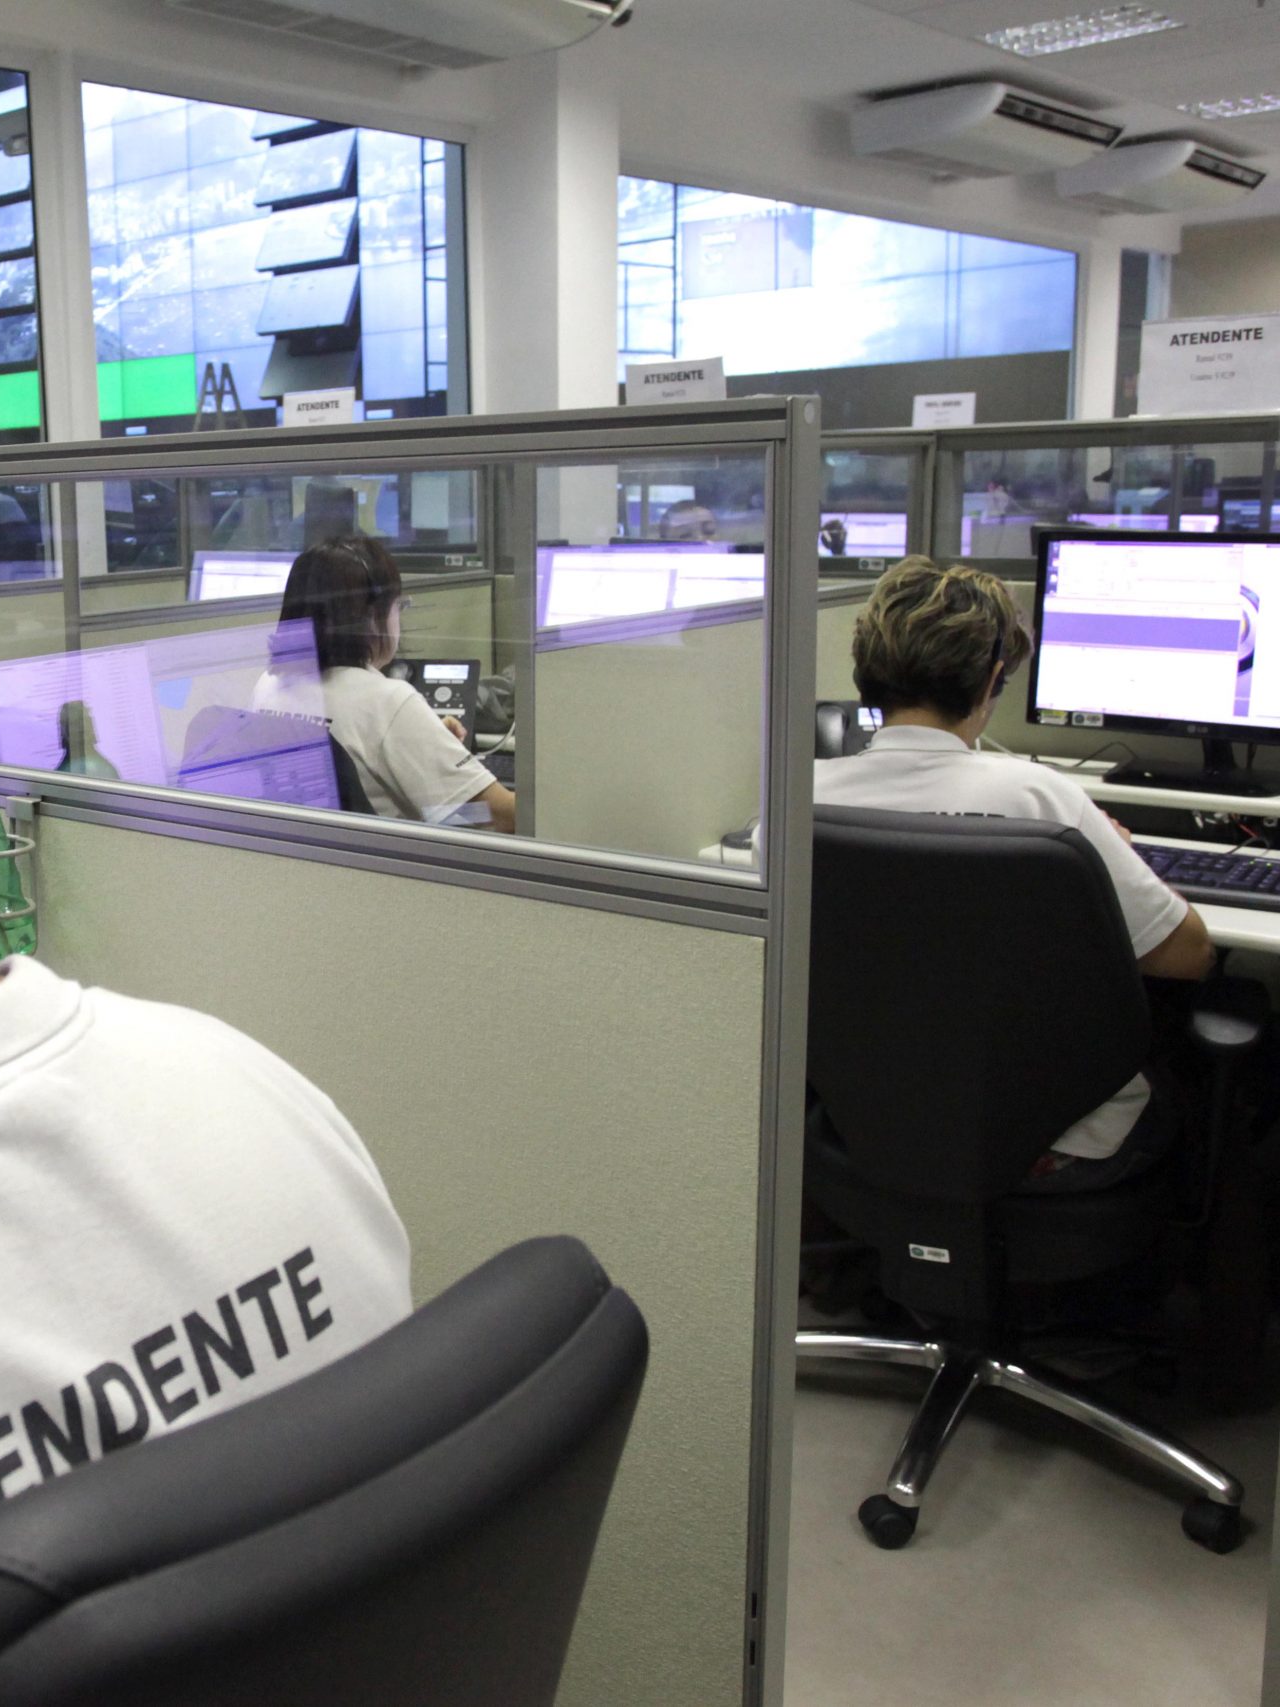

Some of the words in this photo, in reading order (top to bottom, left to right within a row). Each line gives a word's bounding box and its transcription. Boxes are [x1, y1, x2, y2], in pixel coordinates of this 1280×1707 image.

[1169, 327, 1264, 347] ATENDENTE
[644, 369, 704, 385] ATENDENTE
[296, 399, 340, 413] ATENDENTE
